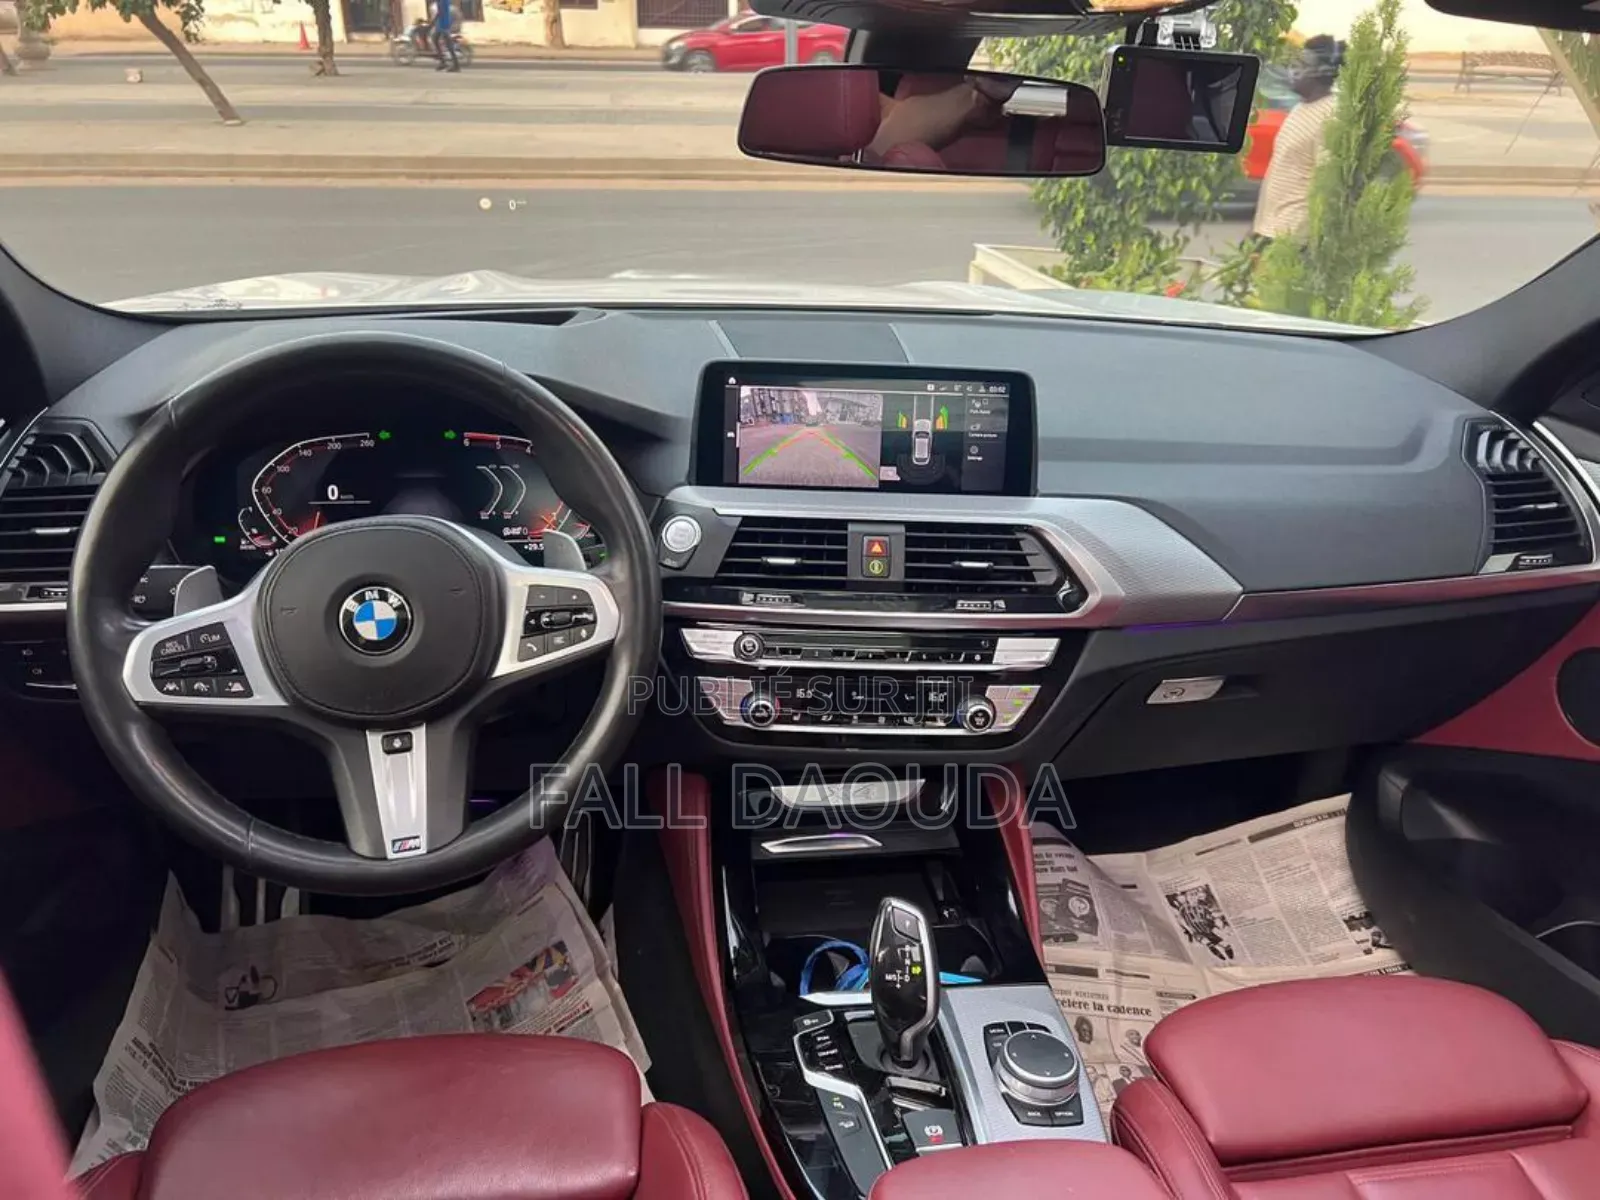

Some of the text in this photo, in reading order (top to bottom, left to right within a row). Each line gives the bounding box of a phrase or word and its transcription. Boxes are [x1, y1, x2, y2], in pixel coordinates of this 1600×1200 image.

[327, 442, 342, 451] 200
[359, 439, 375, 448] 260
[463, 438, 470, 447] 6
[495, 441, 502, 450] 5
[299, 449, 312, 457] 140
[525, 445, 532, 454] 4
[276, 465, 290, 473] 100
[261, 486, 272, 495] 60
[327, 485, 339, 500] 0
[345, 588, 402, 612] BMW
[1106, 1004, 1152, 1017] cadence
